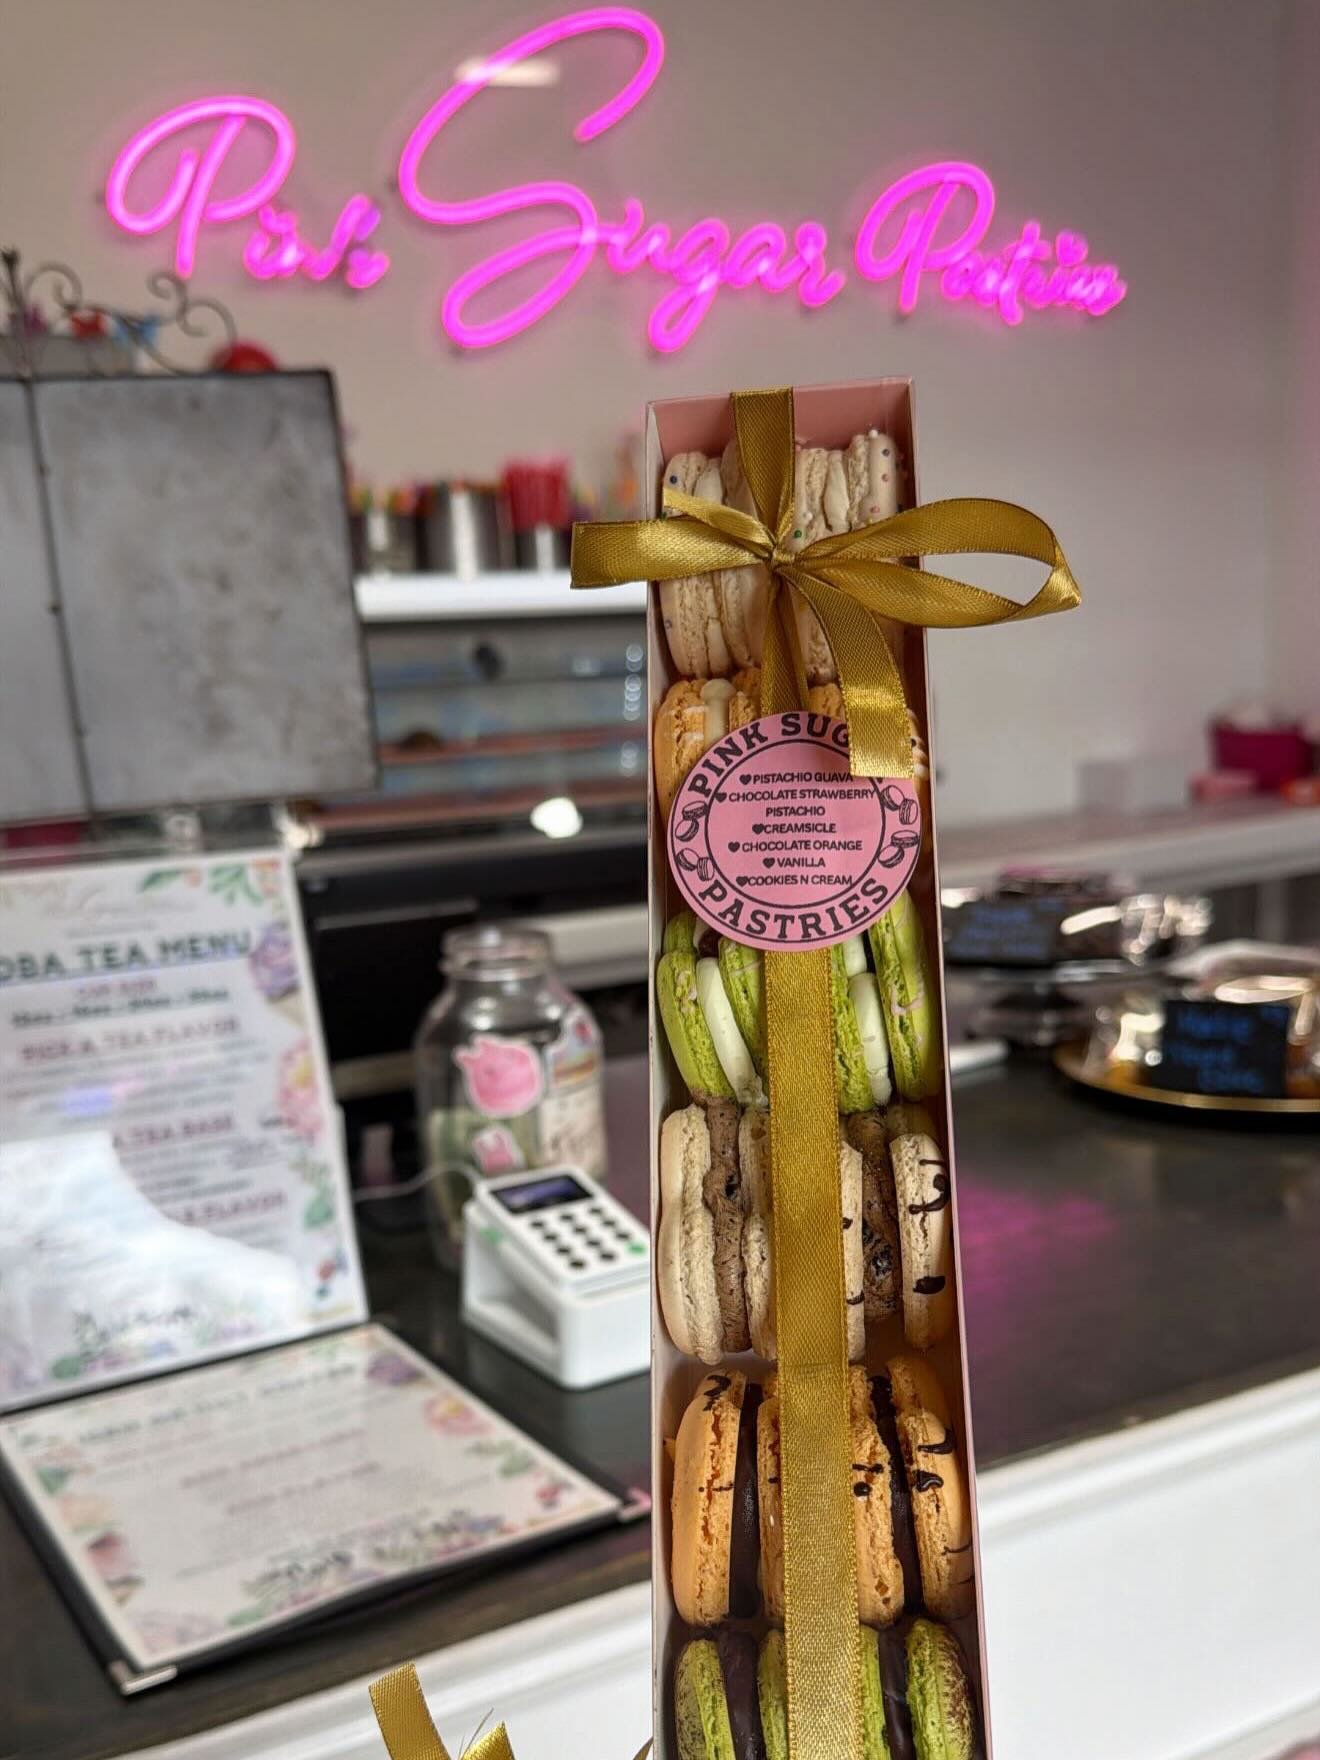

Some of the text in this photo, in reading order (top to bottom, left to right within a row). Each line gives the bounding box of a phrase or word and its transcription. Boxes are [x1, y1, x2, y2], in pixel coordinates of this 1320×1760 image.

[105, 6, 1128, 354] Pink Sugar Pastries
[688, 723, 768, 797] PINK
[753, 772, 854, 784] PISTACHIO GUAVA
[729, 788, 876, 802] CHOCOLATE STRAWBERRY
[765, 806, 826, 817] PISTACHIO
[764, 823, 836, 834] CREAMSICLE
[742, 840, 863, 852] CHOCOLATE ORANGE
[777, 857, 826, 868] VANILLA
[748, 874, 853, 886] COOKIES N CREAM
[698, 878, 889, 940] PASTRIES
[0, 930, 251, 982] OBA TEA MENU
